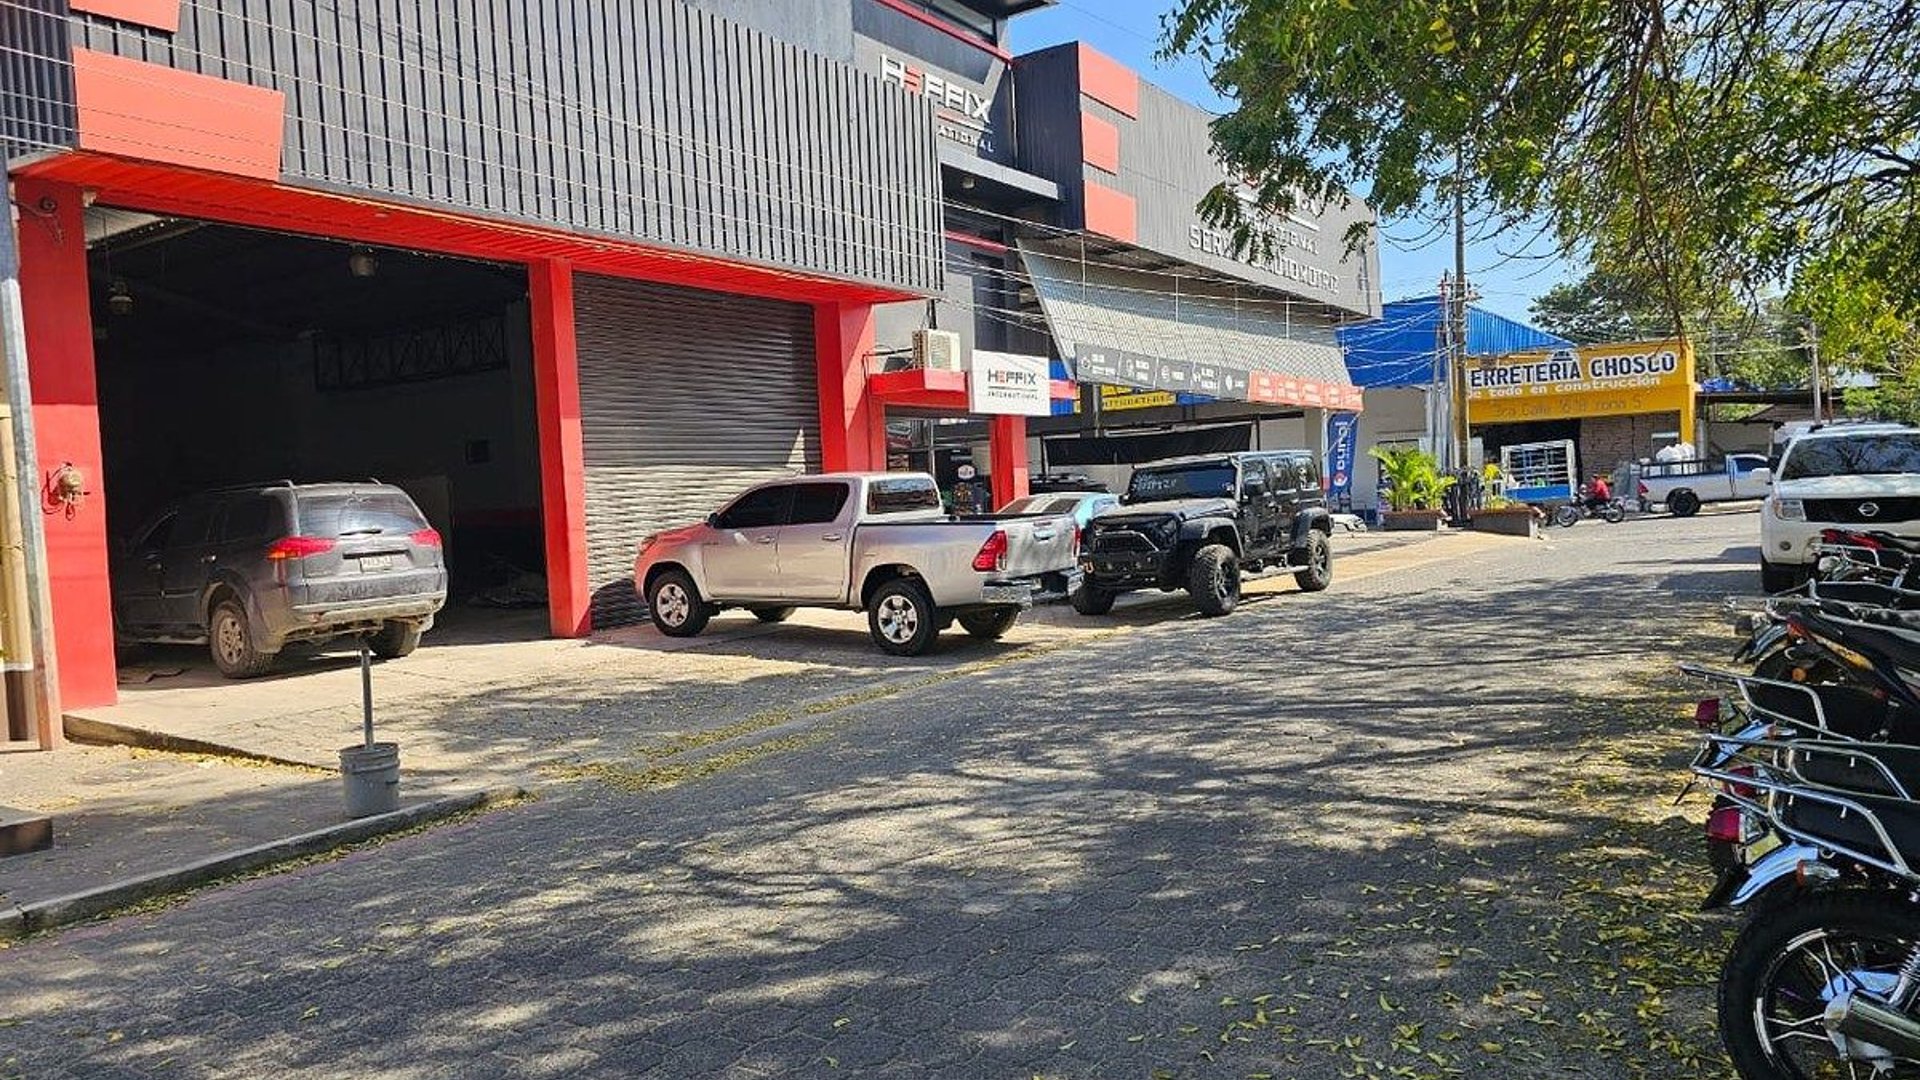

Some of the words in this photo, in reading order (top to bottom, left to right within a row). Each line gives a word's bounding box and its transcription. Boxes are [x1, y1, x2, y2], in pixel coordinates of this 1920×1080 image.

[881, 54, 990, 124] HEFFIX
[937, 125, 994, 152] ATIONAL
[988, 368, 1037, 385] HEFFIX
[1471, 361, 1580, 387] ERRETERIA
[1591, 353, 1675, 377] CHOSCO
[1489, 386, 1523, 398] todo
[1531, 385, 1548, 394] en
[1555, 374, 1661, 393] construcción
